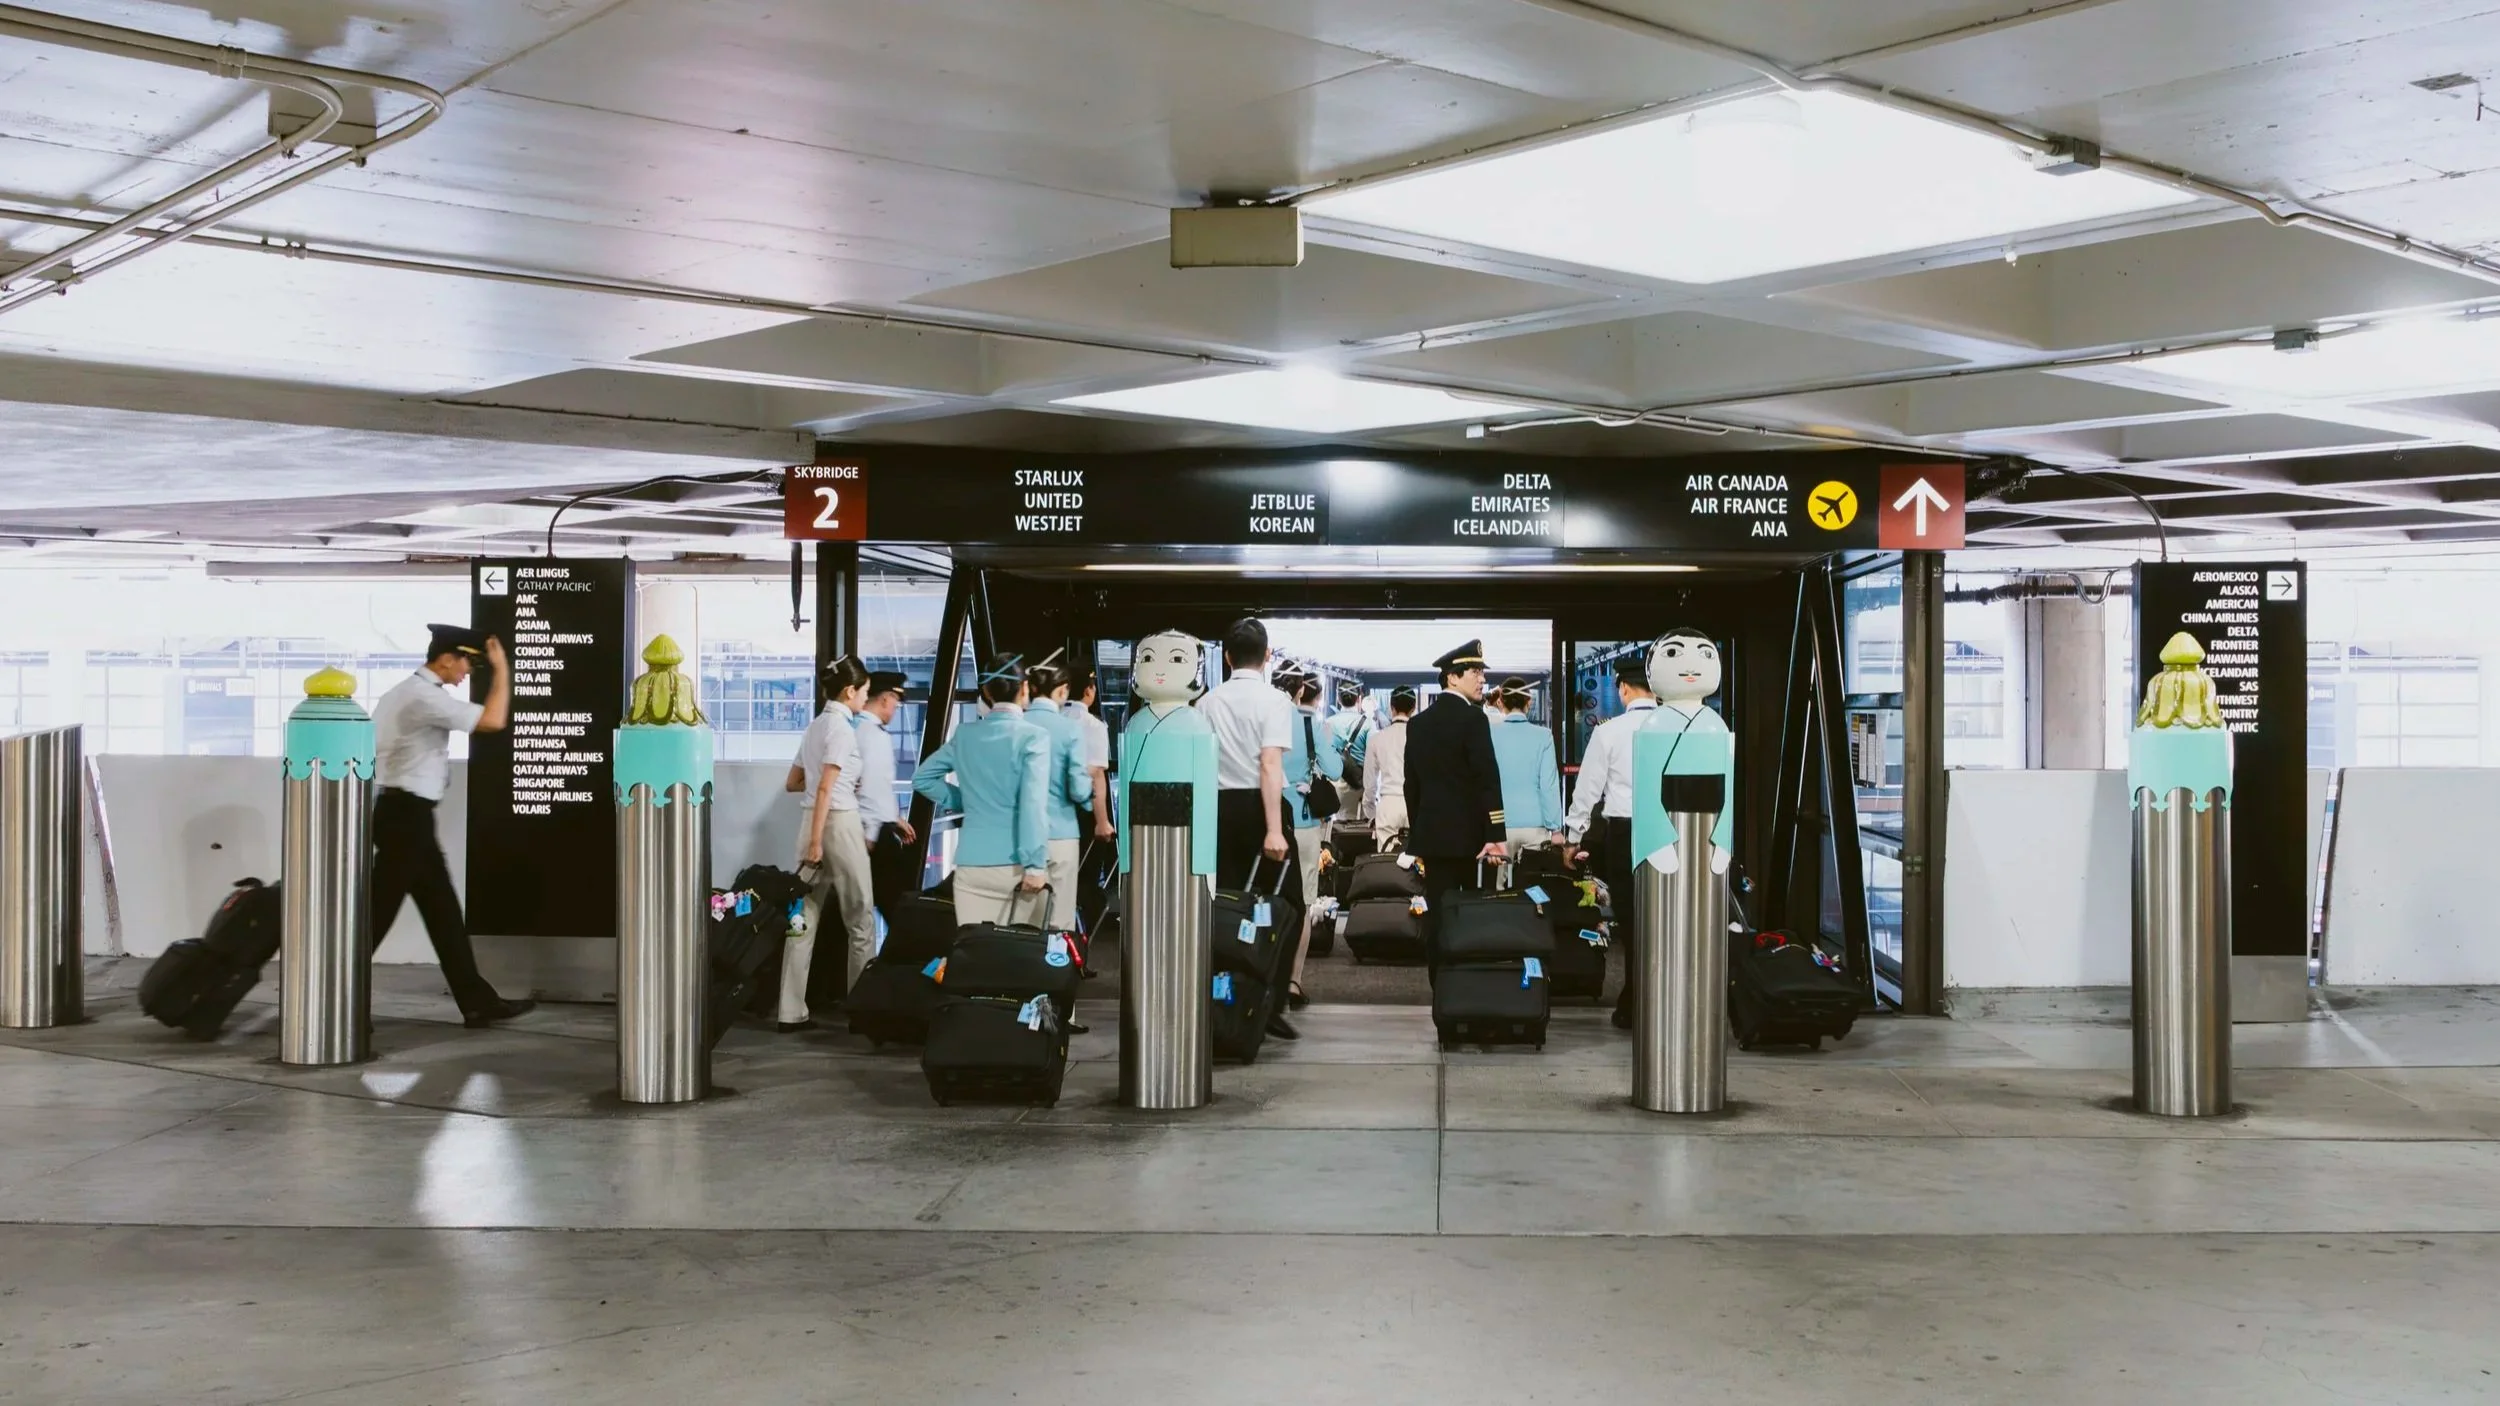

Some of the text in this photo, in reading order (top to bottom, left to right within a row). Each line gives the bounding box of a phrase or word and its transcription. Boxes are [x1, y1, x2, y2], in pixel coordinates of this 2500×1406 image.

[793, 465, 858, 478] SKYBRIDGE
[1015, 470, 1083, 486] STARLUX
[1504, 474, 1551, 489] DELTA
[1686, 475, 1788, 491] AIR CANADA
[1025, 493, 1082, 508] UNITED
[1251, 494, 1315, 510] JETBLUE
[1472, 497, 1551, 514] EMIRATES
[813, 487, 839, 528] 2
[1691, 498, 1787, 514] AIR FRANCE
[1015, 515, 1082, 531] WESTJET
[1250, 517, 1314, 532] KOREAN
[1455, 518, 1550, 537] ICELANDAIR
[1752, 521, 1787, 536] ANA
[516, 568, 569, 578] AER LINGUS
[2193, 572, 2258, 582] AEROMEXICO
[517, 581, 591, 592] CATHAY PACIFIC
[2220, 585, 2259, 595] ALASKA
[516, 594, 538, 604] AMC
[2205, 599, 2258, 609] AMERICAN
[516, 607, 536, 617] ANA
[2181, 613, 2258, 623] CHINA AIRLINES
[515, 620, 550, 630] ASIANA
[2228, 626, 2259, 636] DELTA
[515, 633, 593, 644] BRITISH AIRWAYS
[2211, 640, 2258, 650] FRONTIER
[515, 646, 554, 656] CONDOR
[2207, 654, 2258, 664] HAWAIIAN
[515, 660, 564, 670] EDELWEISS
[515, 673, 551, 683] EVA AIR
[514, 686, 551, 696] FINNAIR
[2240, 681, 2259, 691] SAS
[2217, 695, 2258, 705] THWEST
[514, 712, 592, 723] HAINAN AIRLINES
[2219, 709, 2258, 718] OUNTRY
[514, 725, 585, 736] JAPAN AIRLINES
[2228, 723, 2258, 732] ANTIC
[514, 738, 566, 748] LUFTHANSA
[514, 751, 603, 762] PHILIPPINE AIRLINES
[513, 765, 588, 775] QATAR AIRWAYS
[513, 778, 564, 788] SINGAPORE
[513, 791, 593, 801] TURKISH AIRLINES
[513, 804, 551, 814] VOLARIS
